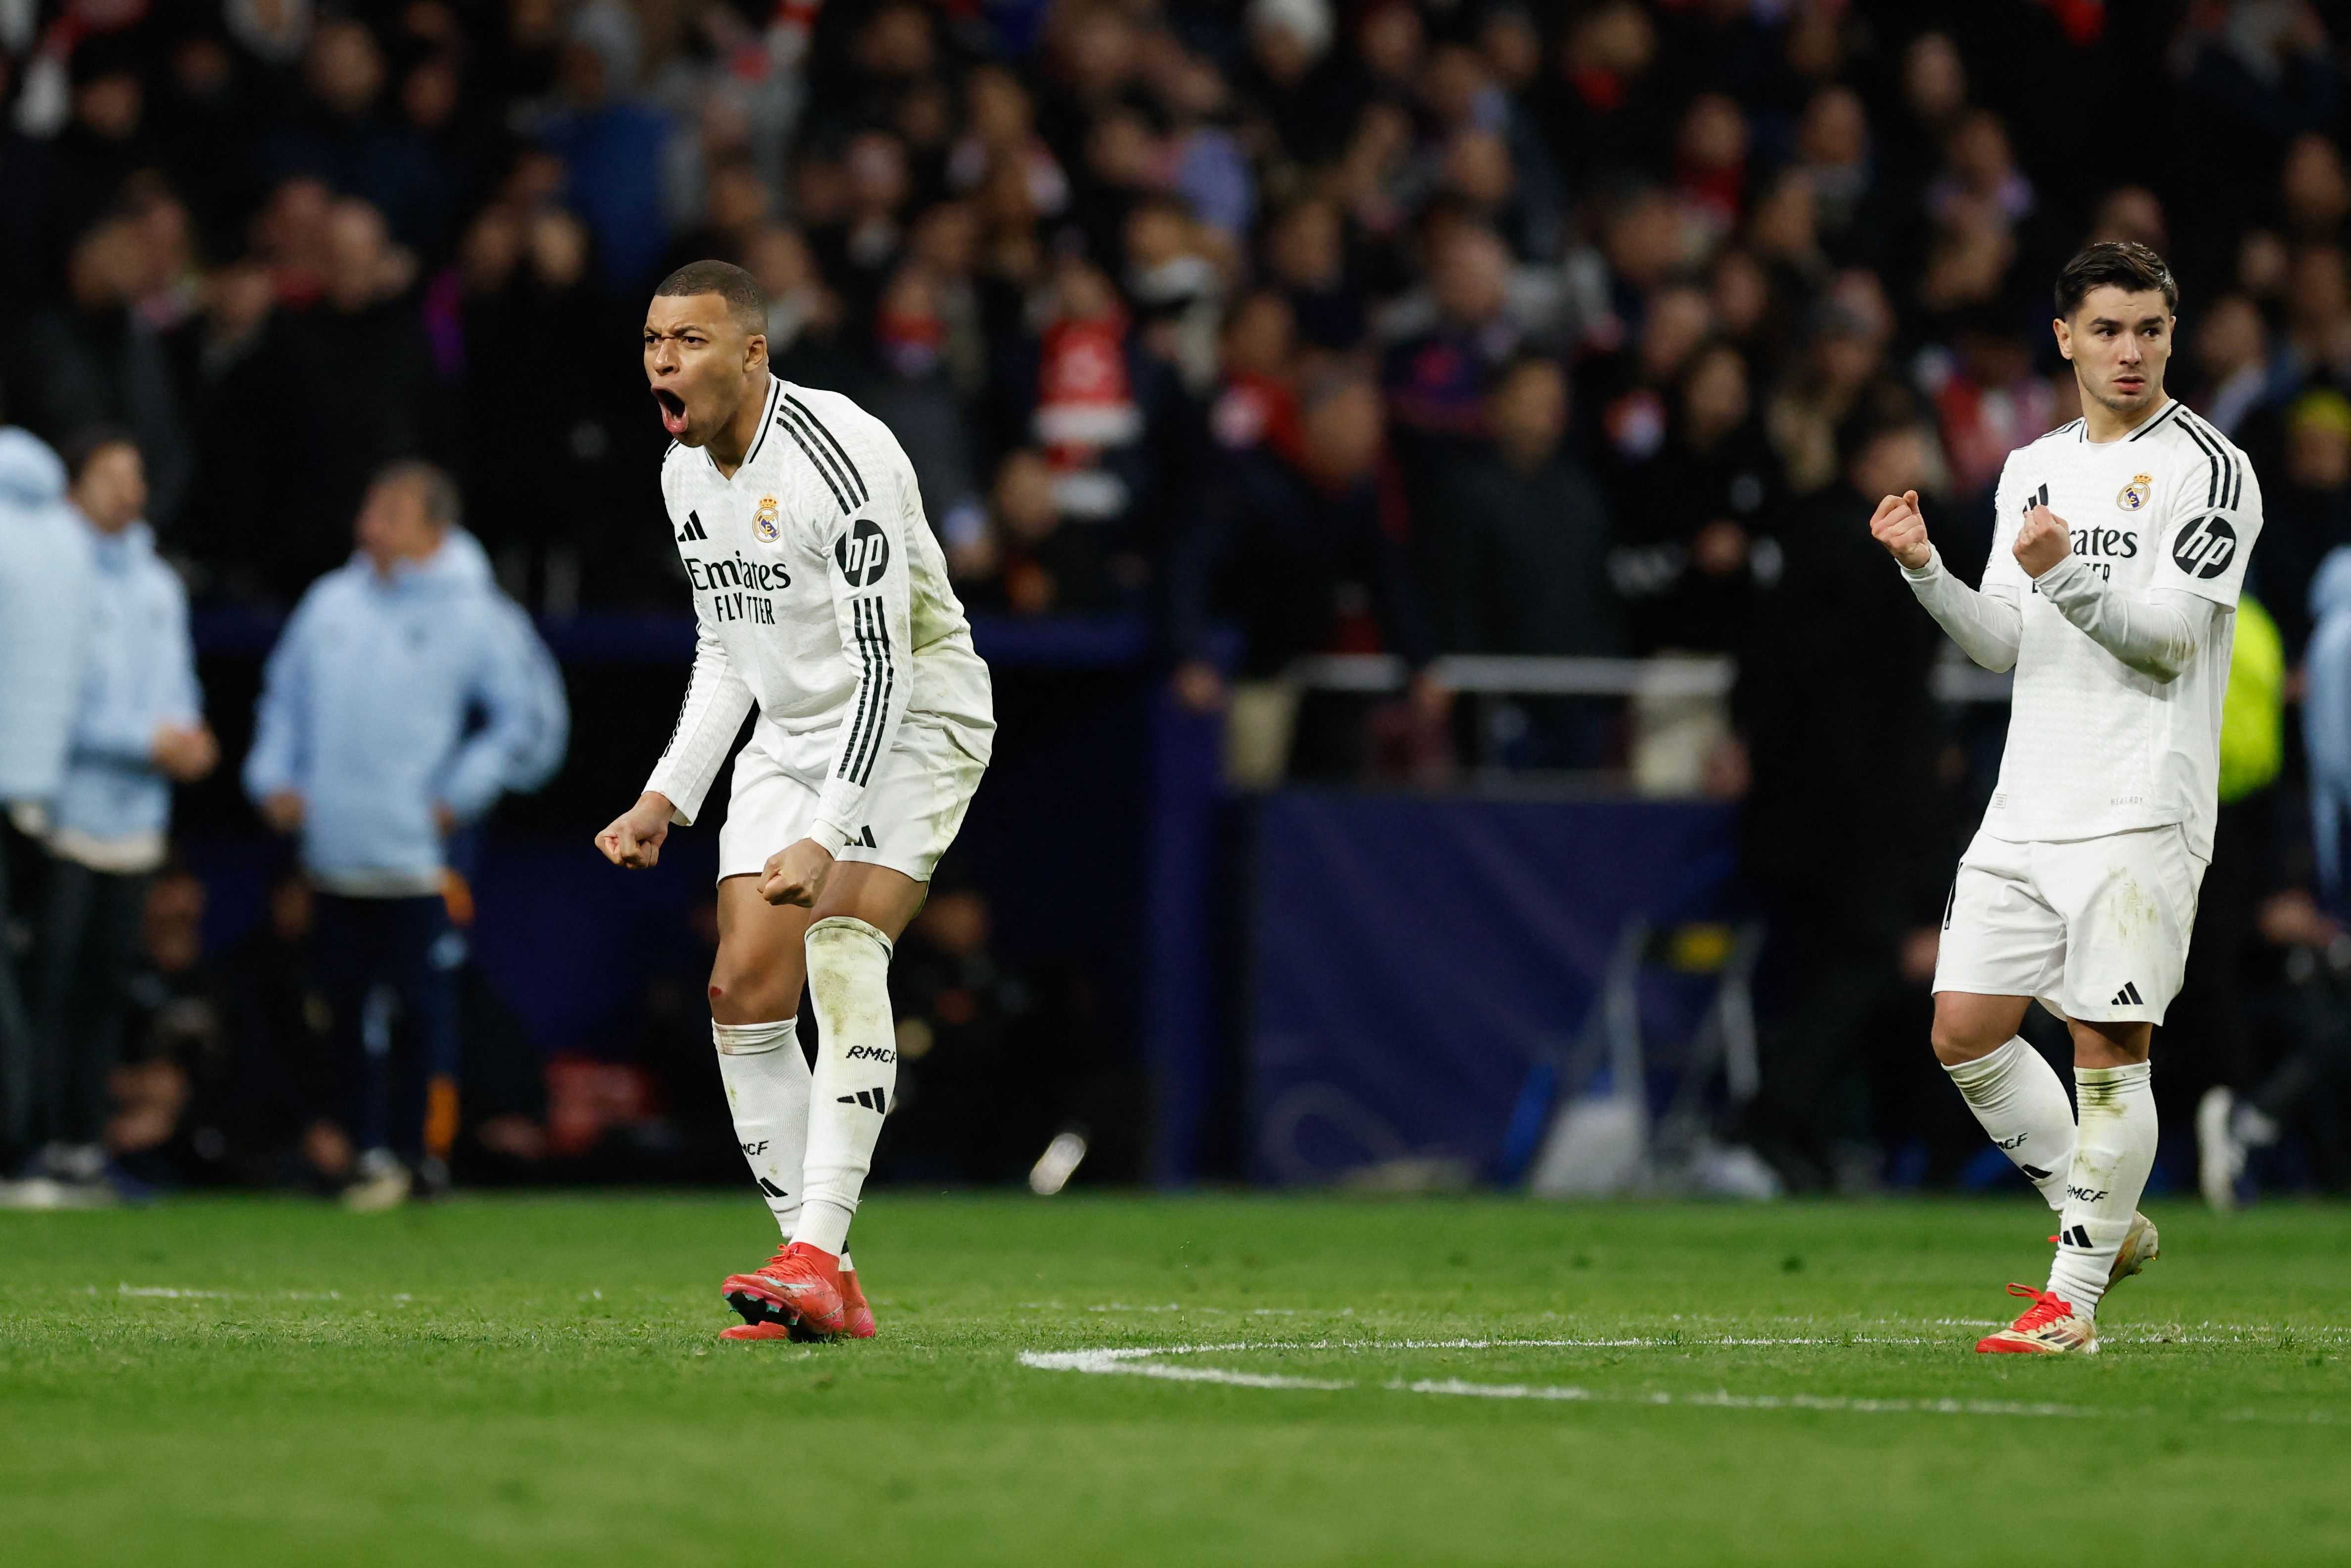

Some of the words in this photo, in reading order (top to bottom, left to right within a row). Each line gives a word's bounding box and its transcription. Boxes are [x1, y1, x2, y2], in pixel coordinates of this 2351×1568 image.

[845, 519, 884, 587] hp
[2069, 524, 2138, 558] ates
[2176, 516, 2234, 577] hp
[684, 550, 791, 591] Emiates
[714, 592, 743, 622] FLY
[747, 596, 775, 624] TTER
